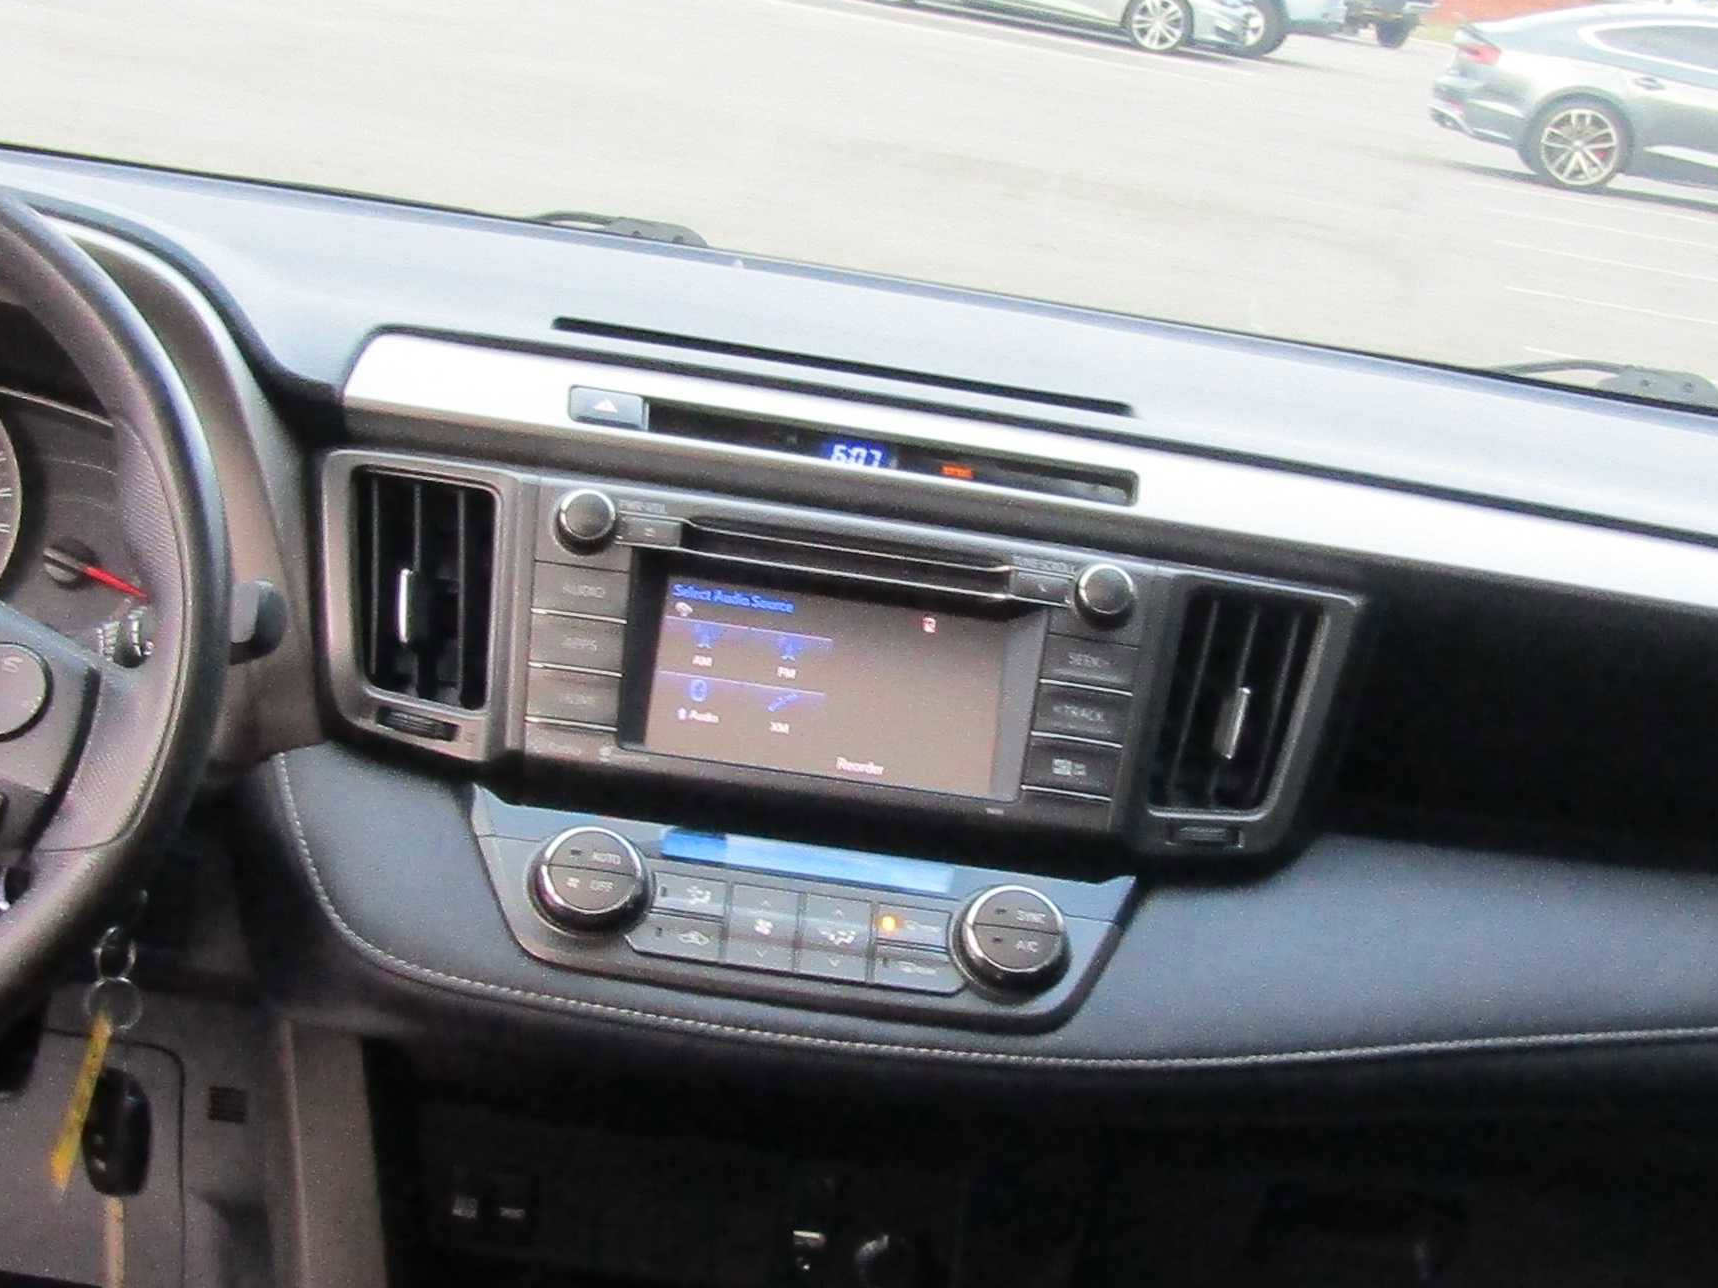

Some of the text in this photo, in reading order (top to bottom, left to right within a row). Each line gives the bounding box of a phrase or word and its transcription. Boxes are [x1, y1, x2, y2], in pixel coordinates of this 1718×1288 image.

[672, 583, 795, 615] Select Audio Source
